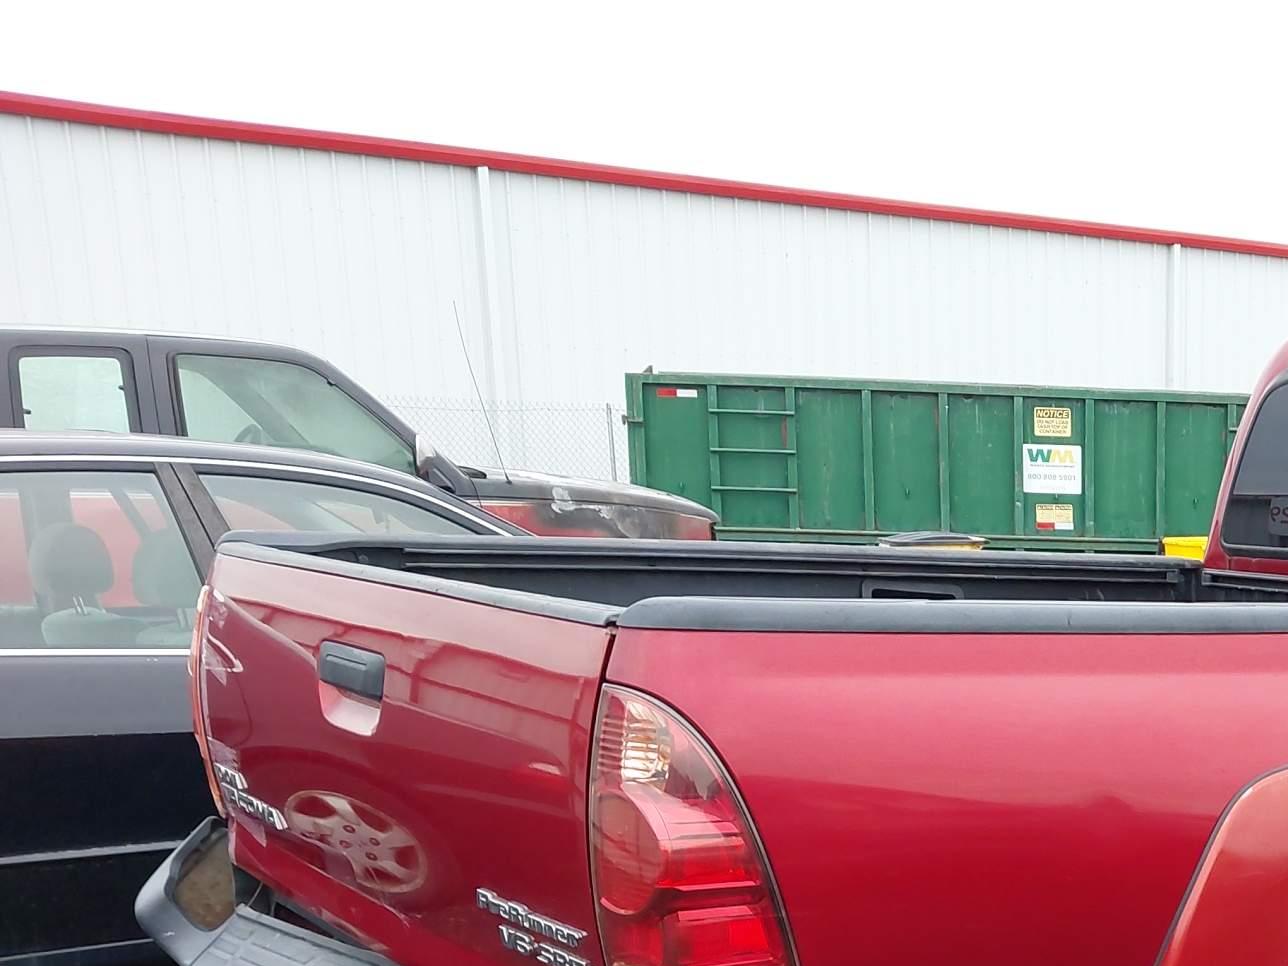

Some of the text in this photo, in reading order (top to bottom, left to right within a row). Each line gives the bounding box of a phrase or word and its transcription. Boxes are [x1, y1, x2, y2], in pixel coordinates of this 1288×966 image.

[1036, 409, 1069, 418] NOTICE
[1027, 448, 1076, 464] WM
[476, 887, 588, 947] PreRunner
[498, 924, 535, 955] V6
